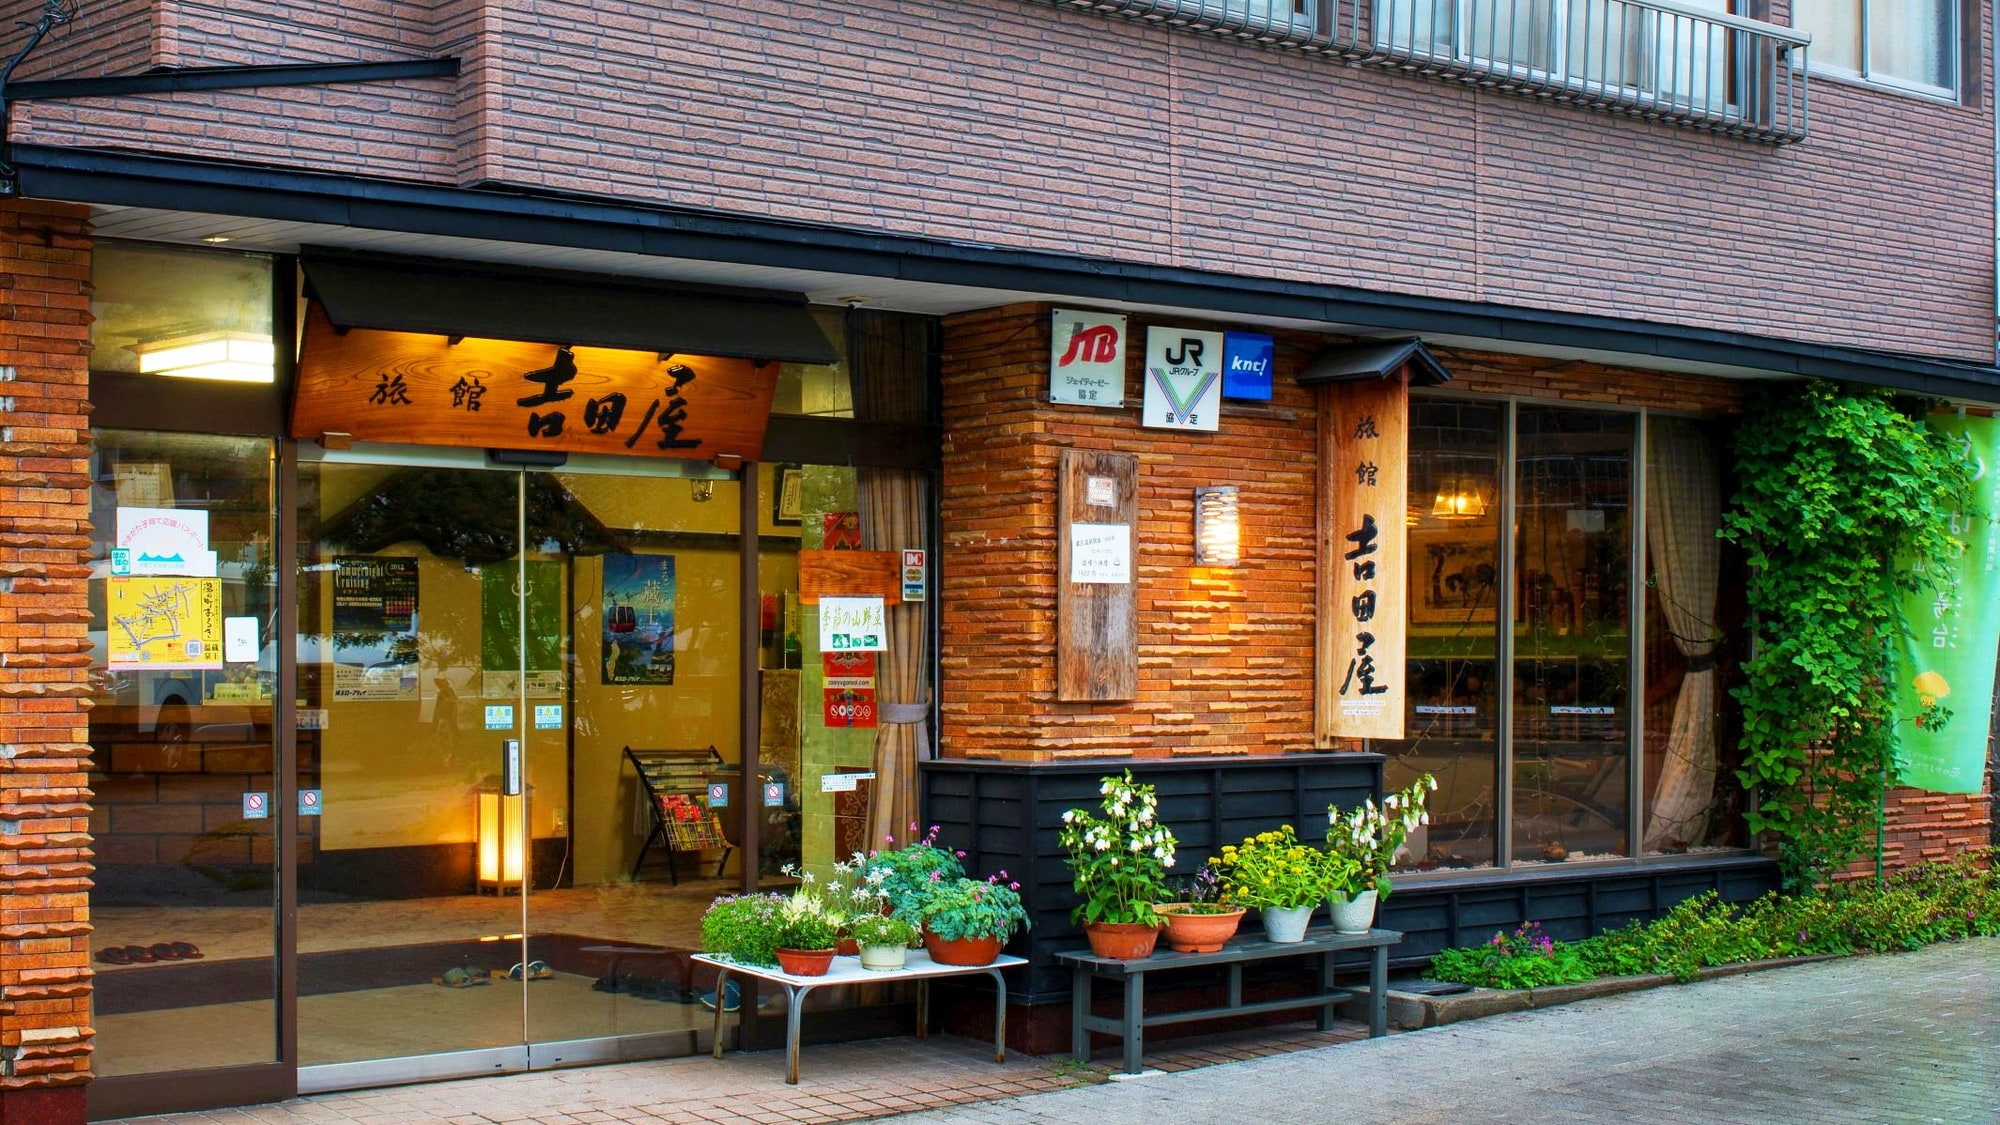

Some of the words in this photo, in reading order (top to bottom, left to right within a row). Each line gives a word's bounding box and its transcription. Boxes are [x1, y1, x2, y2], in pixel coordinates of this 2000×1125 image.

[1059, 322, 1118, 367] JTB
[1166, 338, 1203, 367] JR
[1066, 376, 1110, 387] ジェイティービー
[1169, 367, 1199, 376] JRグループ
[517, 345, 703, 449] 吉田屋
[1078, 388, 1098, 400] 協定
[1339, 513, 1389, 696] 吉田屋
